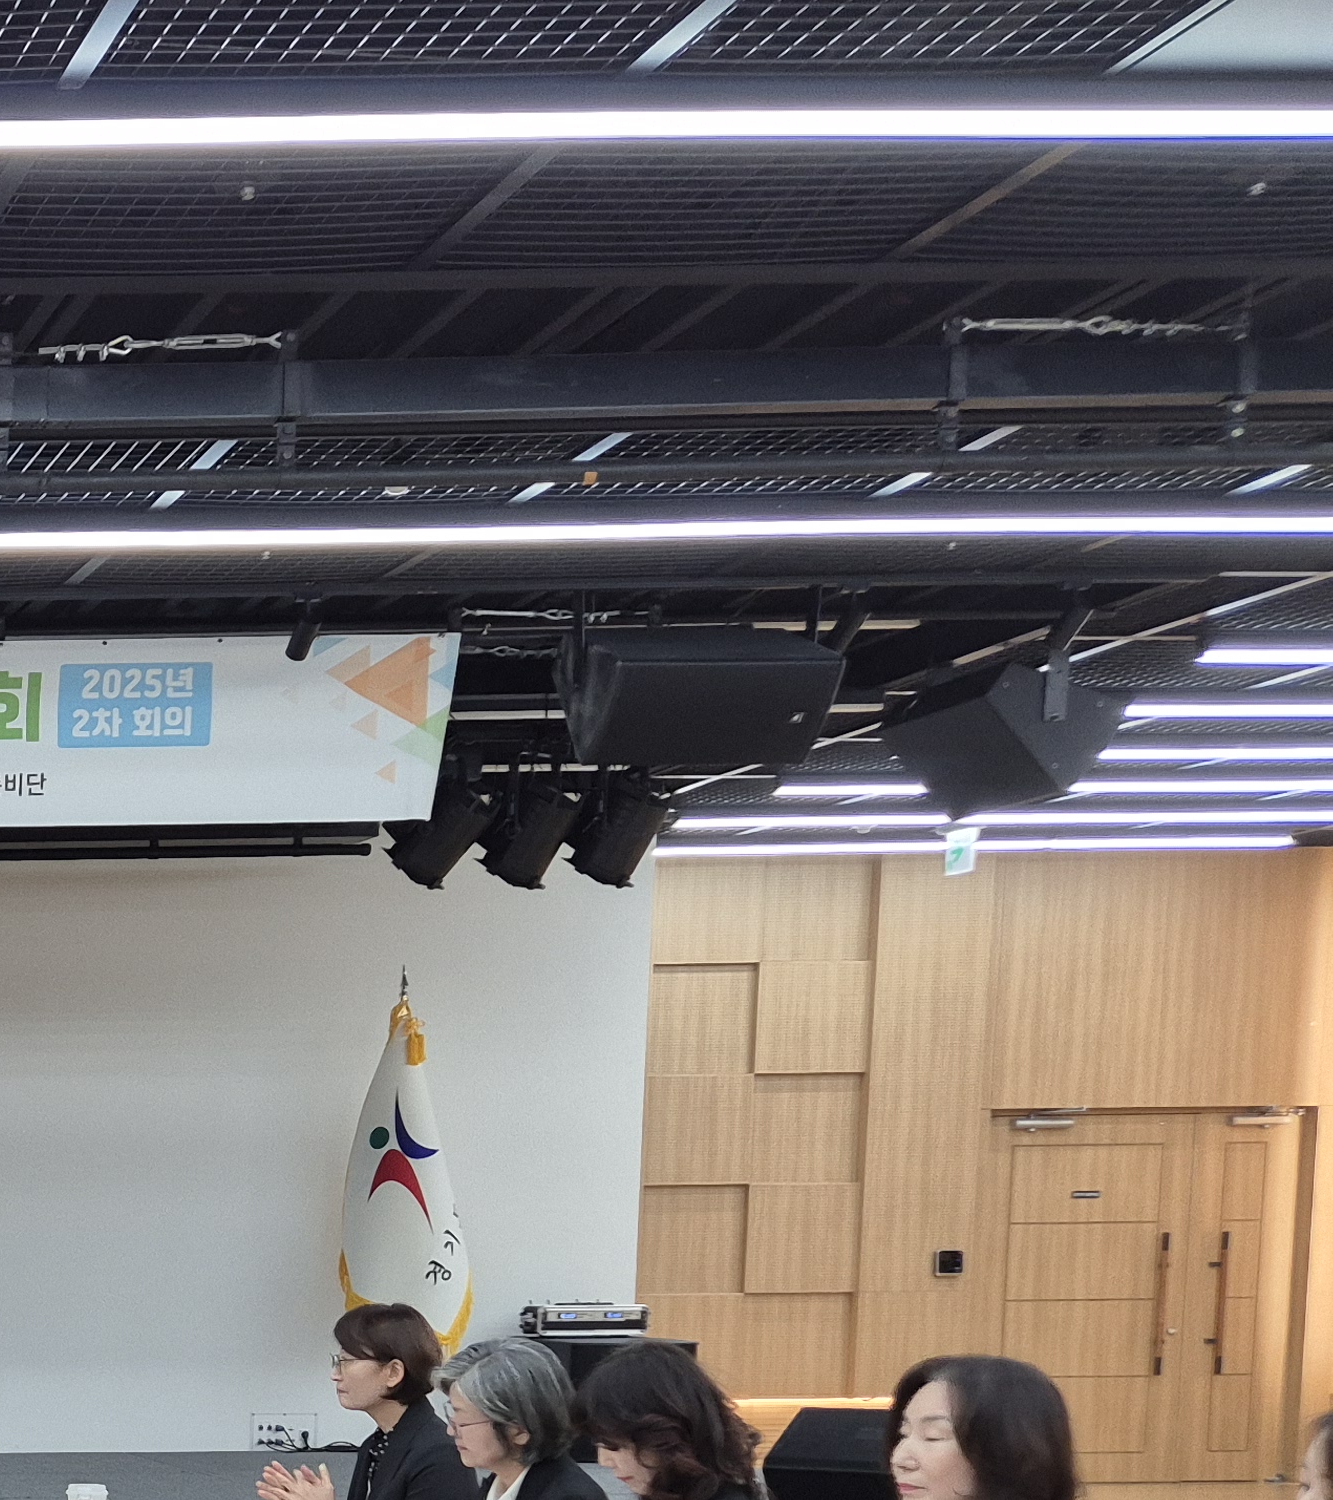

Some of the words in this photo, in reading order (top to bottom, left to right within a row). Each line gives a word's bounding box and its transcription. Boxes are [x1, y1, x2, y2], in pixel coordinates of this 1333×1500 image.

[81, 667, 194, 699] 2025년
[71, 707, 123, 738] 2차
[132, 705, 193, 737] 회의
